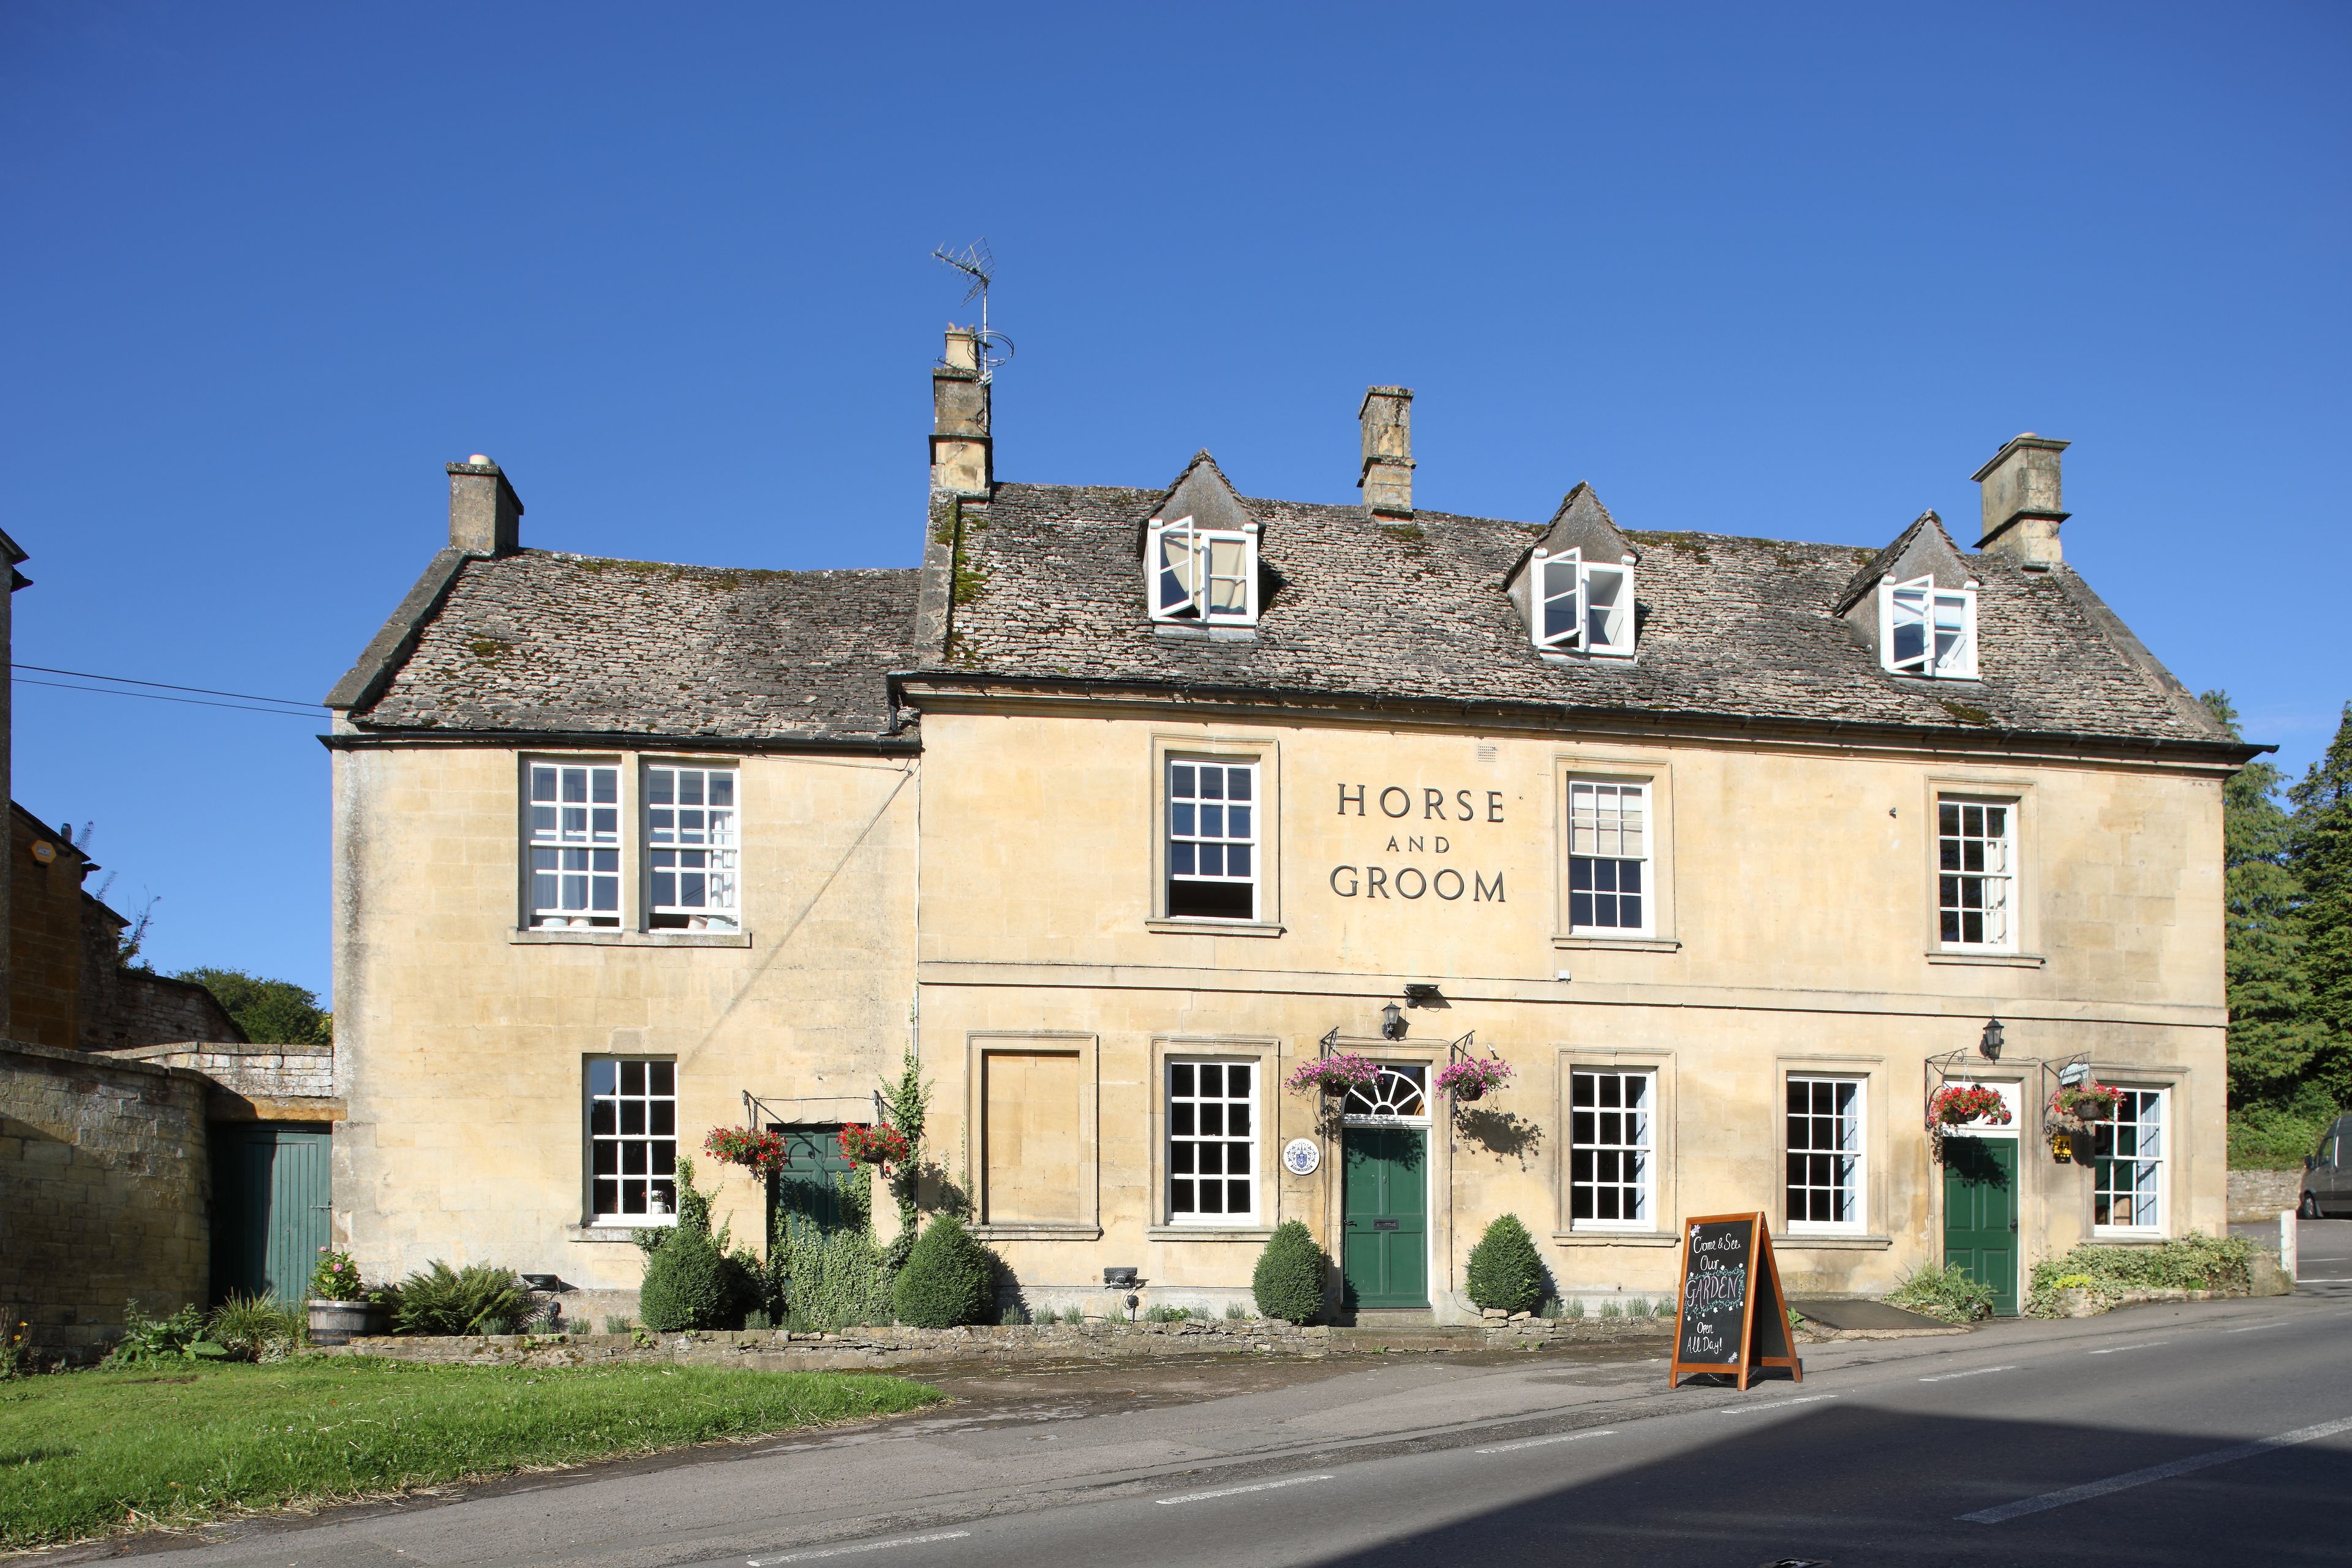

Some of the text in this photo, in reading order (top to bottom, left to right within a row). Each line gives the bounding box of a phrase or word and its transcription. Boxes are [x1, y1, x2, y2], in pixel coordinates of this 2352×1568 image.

[1337, 783, 1504, 823] HORSE
[1386, 835, 1450, 853] AND
[1330, 865, 1506, 902] GROOM
[2058, 1141, 2070, 1151] AA
[1693, 1233, 1741, 1254] Come & See
[1700, 1255, 1719, 1271] Our
[1686, 1273, 1740, 1309] GARDEN
[1697, 1321, 1714, 1335] Open
[1686, 1336, 1722, 1354] All Day!
